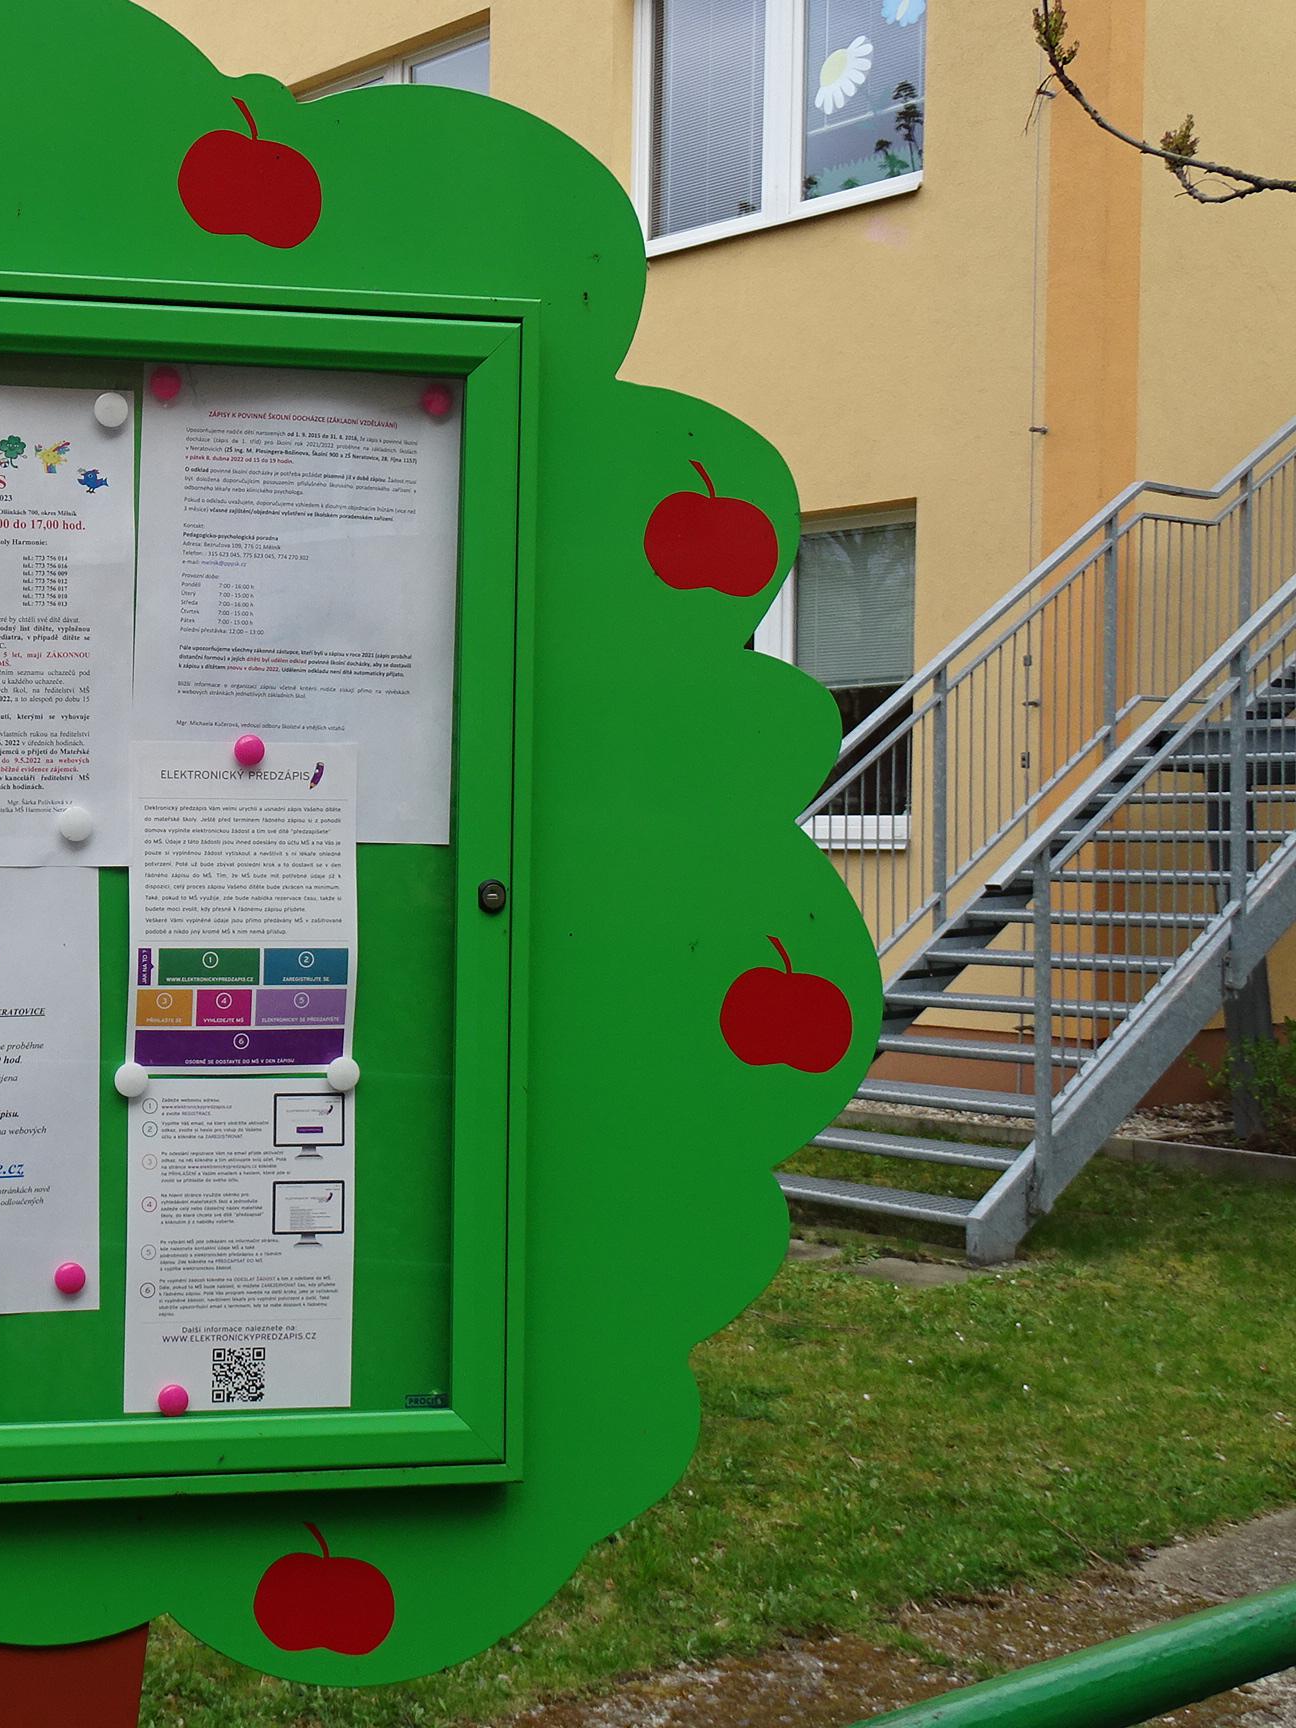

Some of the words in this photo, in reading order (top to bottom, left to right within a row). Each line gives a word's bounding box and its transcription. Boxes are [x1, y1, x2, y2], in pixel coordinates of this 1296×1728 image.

[209, 410, 230, 418] ZÁPISY
[238, 411, 266, 420] POVINNÉ
[268, 412, 291, 421] ŠKOLNÍ
[293, 414, 325, 423] DOCHÁZCE
[13, 519, 26, 529] do
[31, 519, 58, 530] 17,00
[62, 520, 85, 530] hod.
[161, 769, 244, 780] ELEKTRONICKÝ
[248, 769, 310, 781] PŘEDZÁPIS
[6, 1041, 43, 1052] proběhne
[8, 1125, 46, 1136] webových
[162, 1332, 317, 1343] WWW.ELEKTRONICKYPREDZAPIS.CZ
